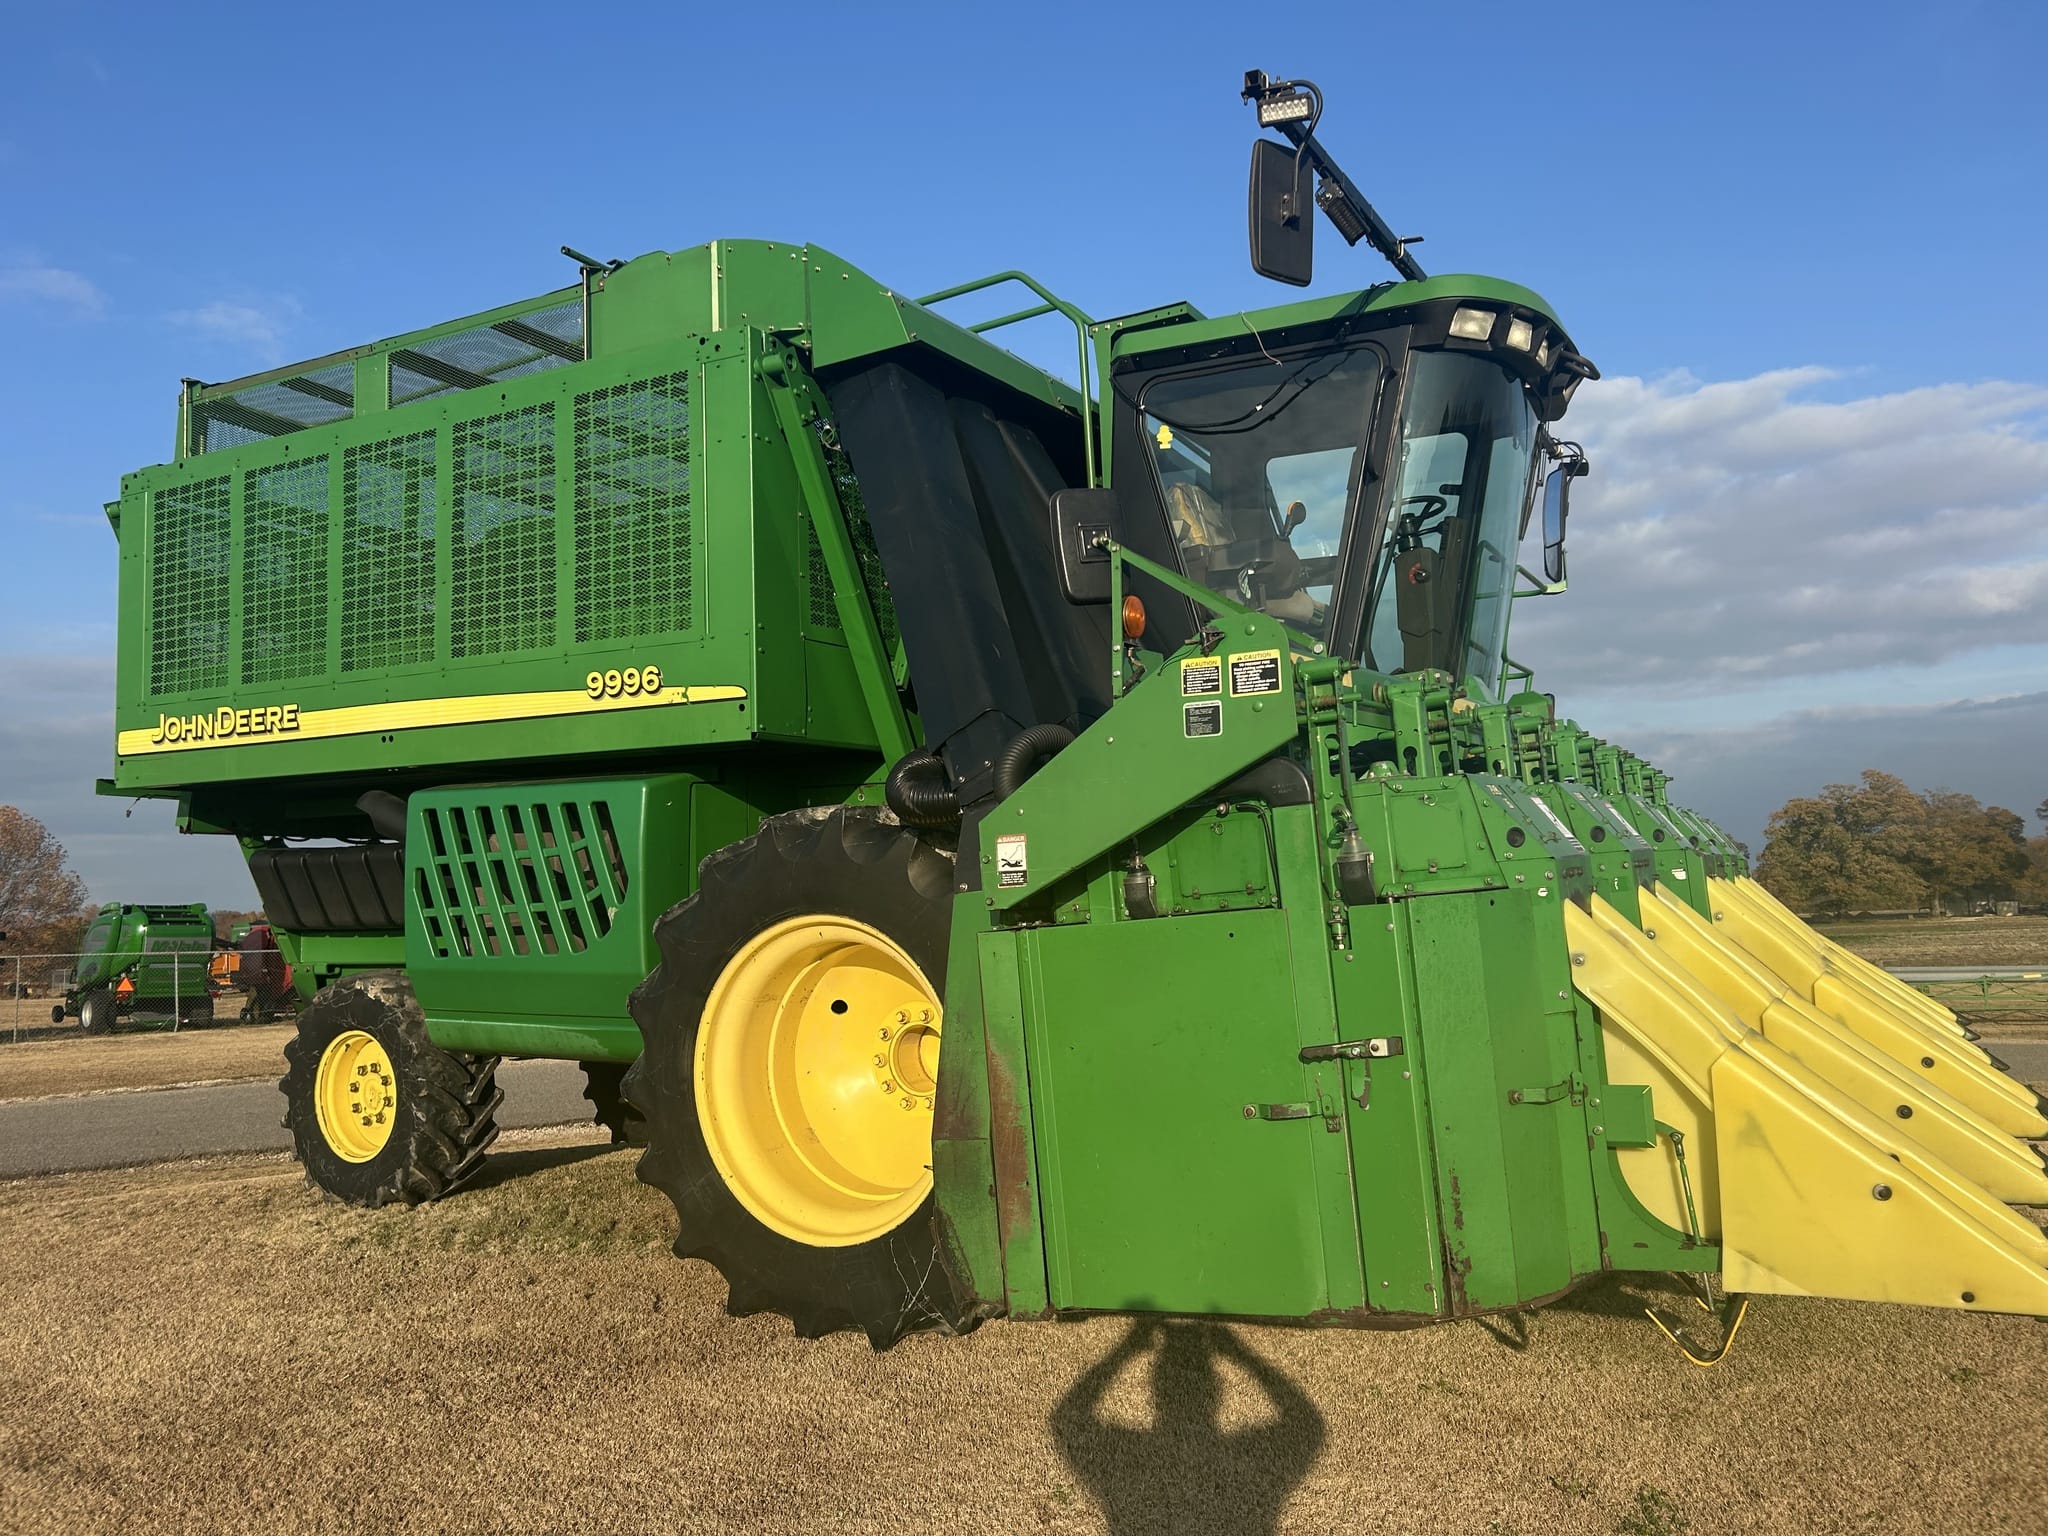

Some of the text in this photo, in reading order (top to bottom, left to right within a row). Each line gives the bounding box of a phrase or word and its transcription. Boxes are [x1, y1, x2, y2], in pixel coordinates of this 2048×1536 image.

[1244, 652, 1271, 660] CAUTION
[586, 665, 660, 698] 9996
[151, 704, 298, 742] JOHN DEERE
